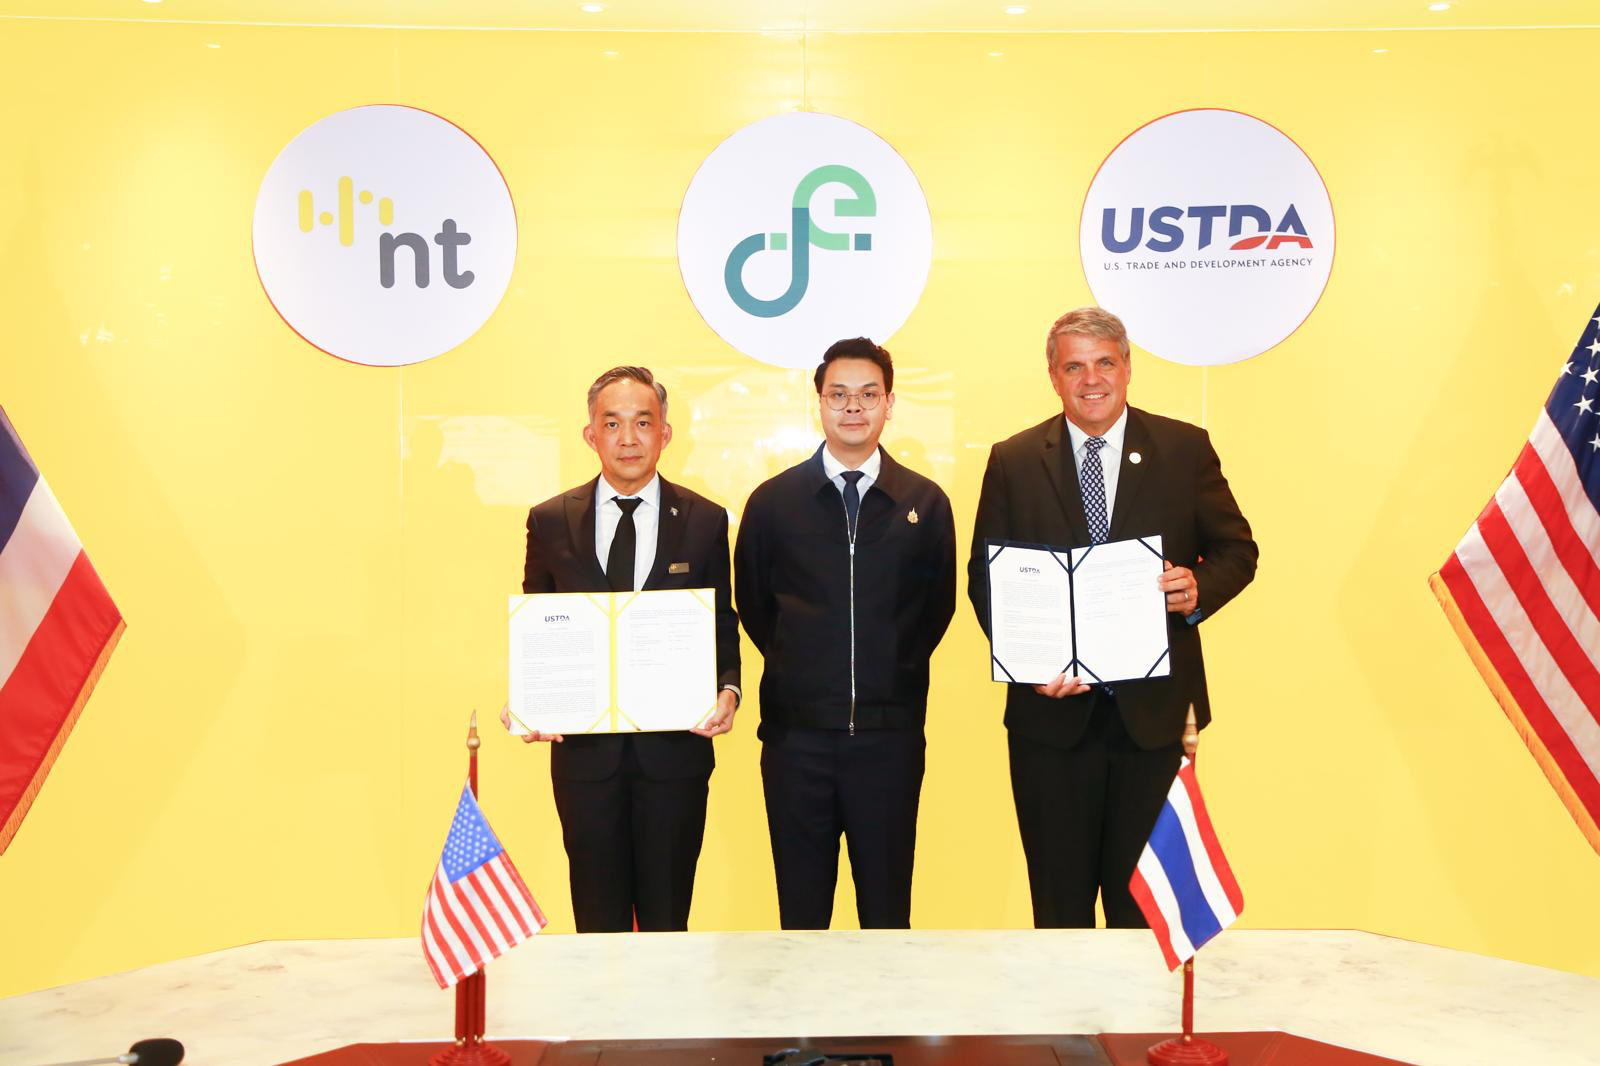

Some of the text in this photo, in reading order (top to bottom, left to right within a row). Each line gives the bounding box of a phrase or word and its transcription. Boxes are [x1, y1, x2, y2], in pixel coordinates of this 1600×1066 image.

[1101, 203, 1314, 253] USTDA
[379, 218, 475, 289] nt
[1104, 258, 1313, 270] U.S. TRADE AND DEVELOPMENT AGENCY
